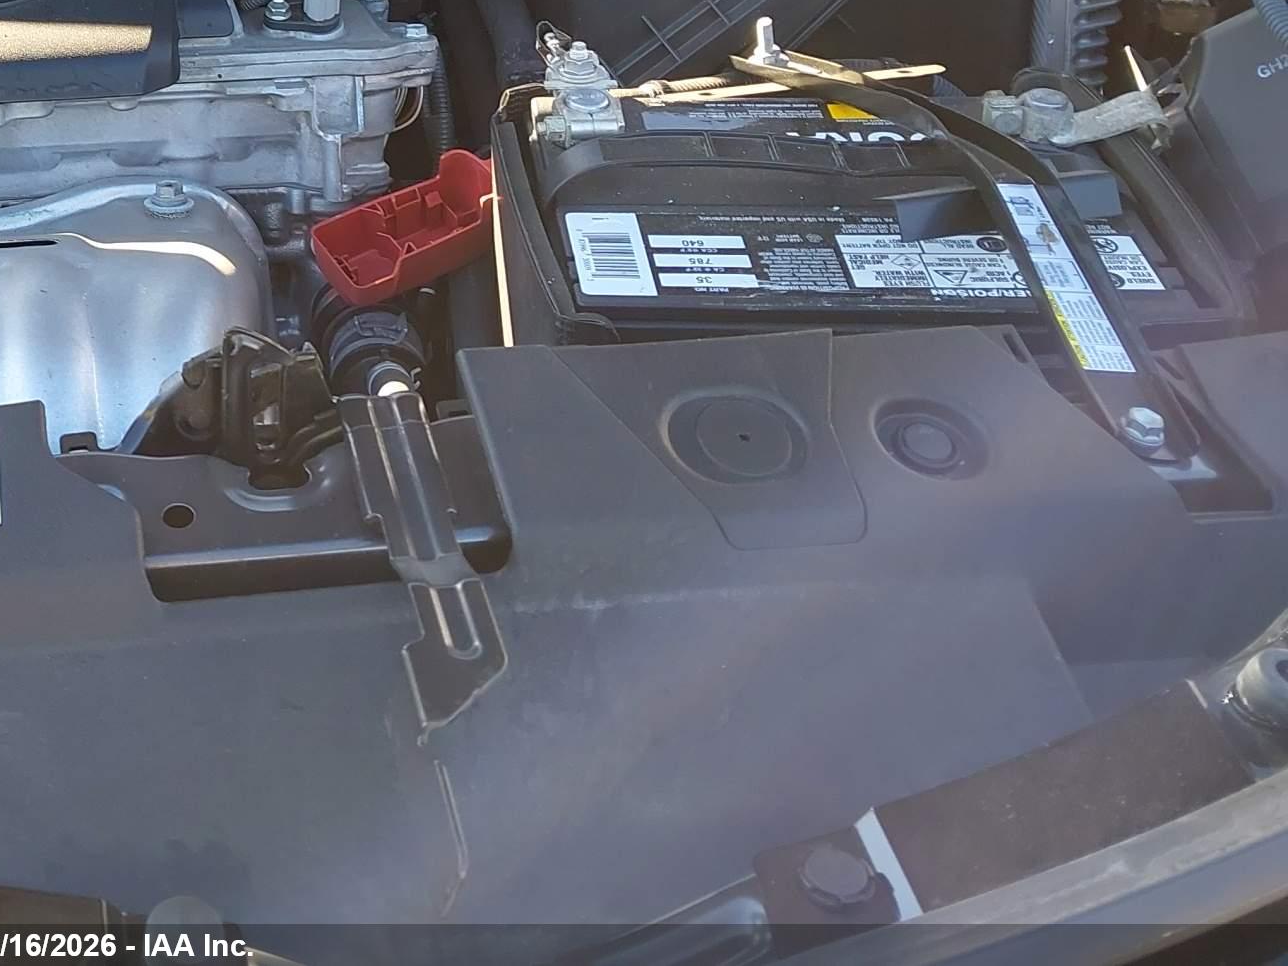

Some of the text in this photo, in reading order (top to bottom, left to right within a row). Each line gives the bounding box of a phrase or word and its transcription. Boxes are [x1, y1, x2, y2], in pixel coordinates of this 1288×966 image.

[681, 239, 705, 247] 640
[688, 257, 712, 265] 785
[695, 276, 713, 284] 35
[930, 288, 1032, 298] ER/POISON
